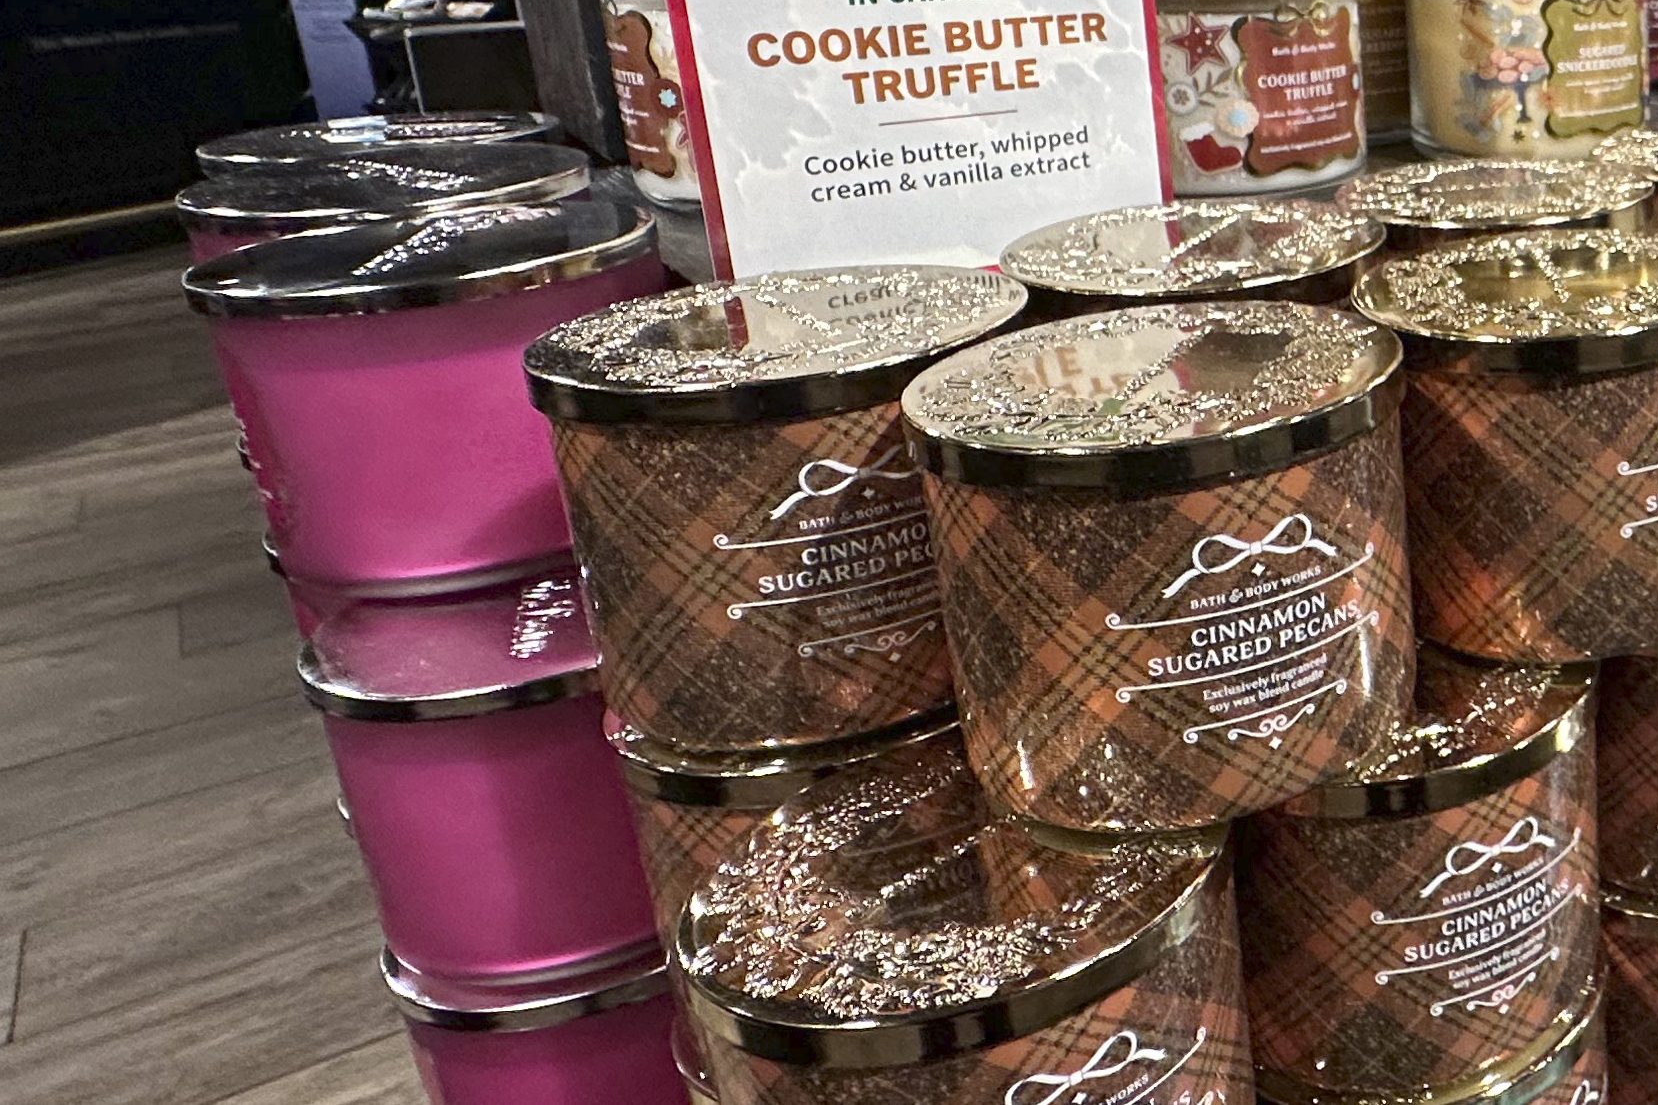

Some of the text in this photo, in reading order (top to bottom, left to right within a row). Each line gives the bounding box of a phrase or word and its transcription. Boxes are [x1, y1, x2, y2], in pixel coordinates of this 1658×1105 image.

[746, 12, 1107, 67] COOKIE BUTTER
[842, 58, 1041, 105] TRUFFLE
[1258, 72, 1308, 88] COOKIE
[1284, 82, 1333, 101] TRUFFLE
[804, 126, 1090, 176] Cookie butter, whipped
[810, 152, 1092, 203] cream & vanilla extract
[799, 516, 835, 530] BATH
[801, 522, 926, 566] CINNAMO
[758, 556, 887, 594] SUGARED
[1190, 565, 1321, 610] BATH & BODY WORKS
[1147, 598, 1362, 677] SUGARED PECANS
[1191, 592, 1326, 647] CINNAMON
[1203, 652, 1327, 701] Exclusively fragranced
[1209, 669, 1324, 713] soy wax blend candle
[1404, 877, 1569, 962] SUGARED PECANS
[1441, 879, 1547, 936] CINNAMON
[1442, 891, 1471, 905] BATH
